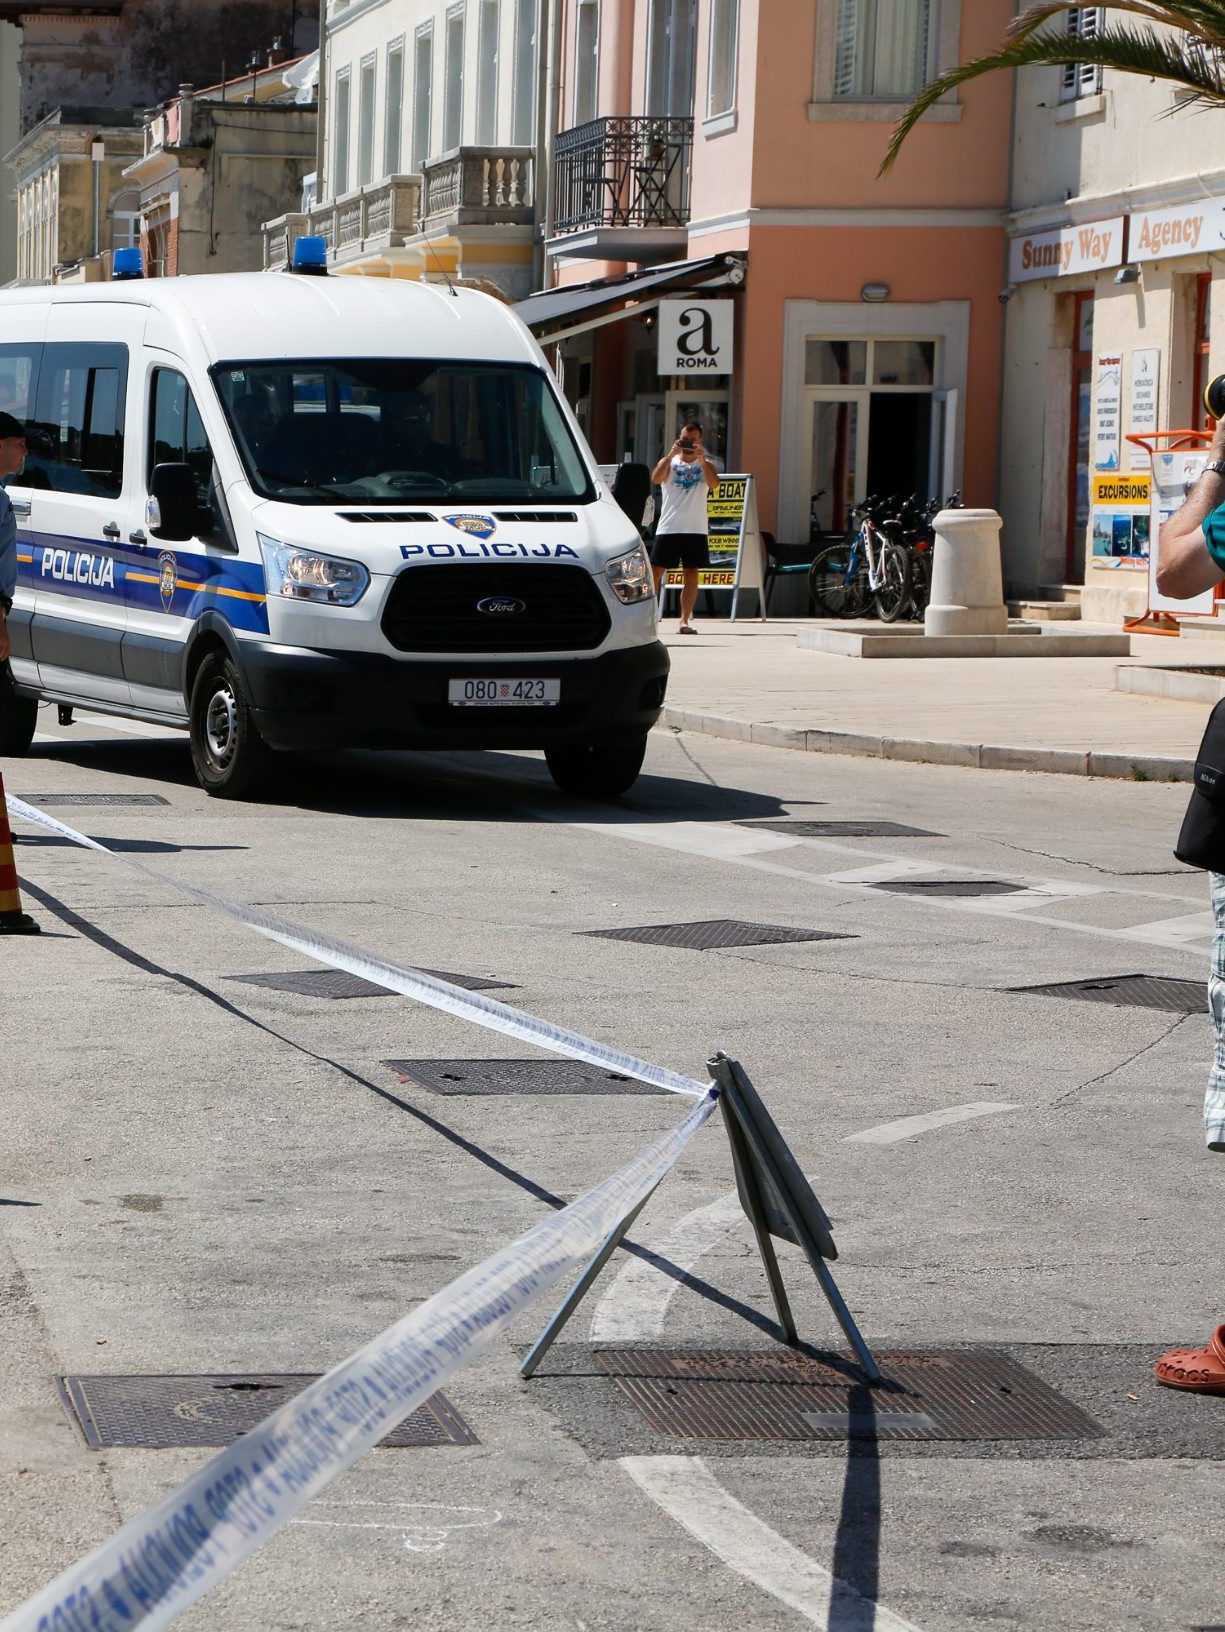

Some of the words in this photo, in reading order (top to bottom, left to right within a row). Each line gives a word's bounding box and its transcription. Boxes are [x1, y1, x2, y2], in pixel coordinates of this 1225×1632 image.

[1139, 216, 1204, 255] Agency
[1022, 240, 1074, 270] Sunny
[1078, 228, 1112, 263] Way
[677, 308, 720, 356] a
[676, 358, 718, 368] ROMA
[719, 482, 747, 498] BOAT
[1098, 484, 1148, 499] EXCURSIONS
[399, 543, 580, 559] POLICIJA
[41, 547, 115, 589] POLICIJA
[703, 573, 734, 584] HERE
[489, 600, 516, 612] Ford
[464, 680, 497, 700] 080
[513, 680, 545, 700] 423
